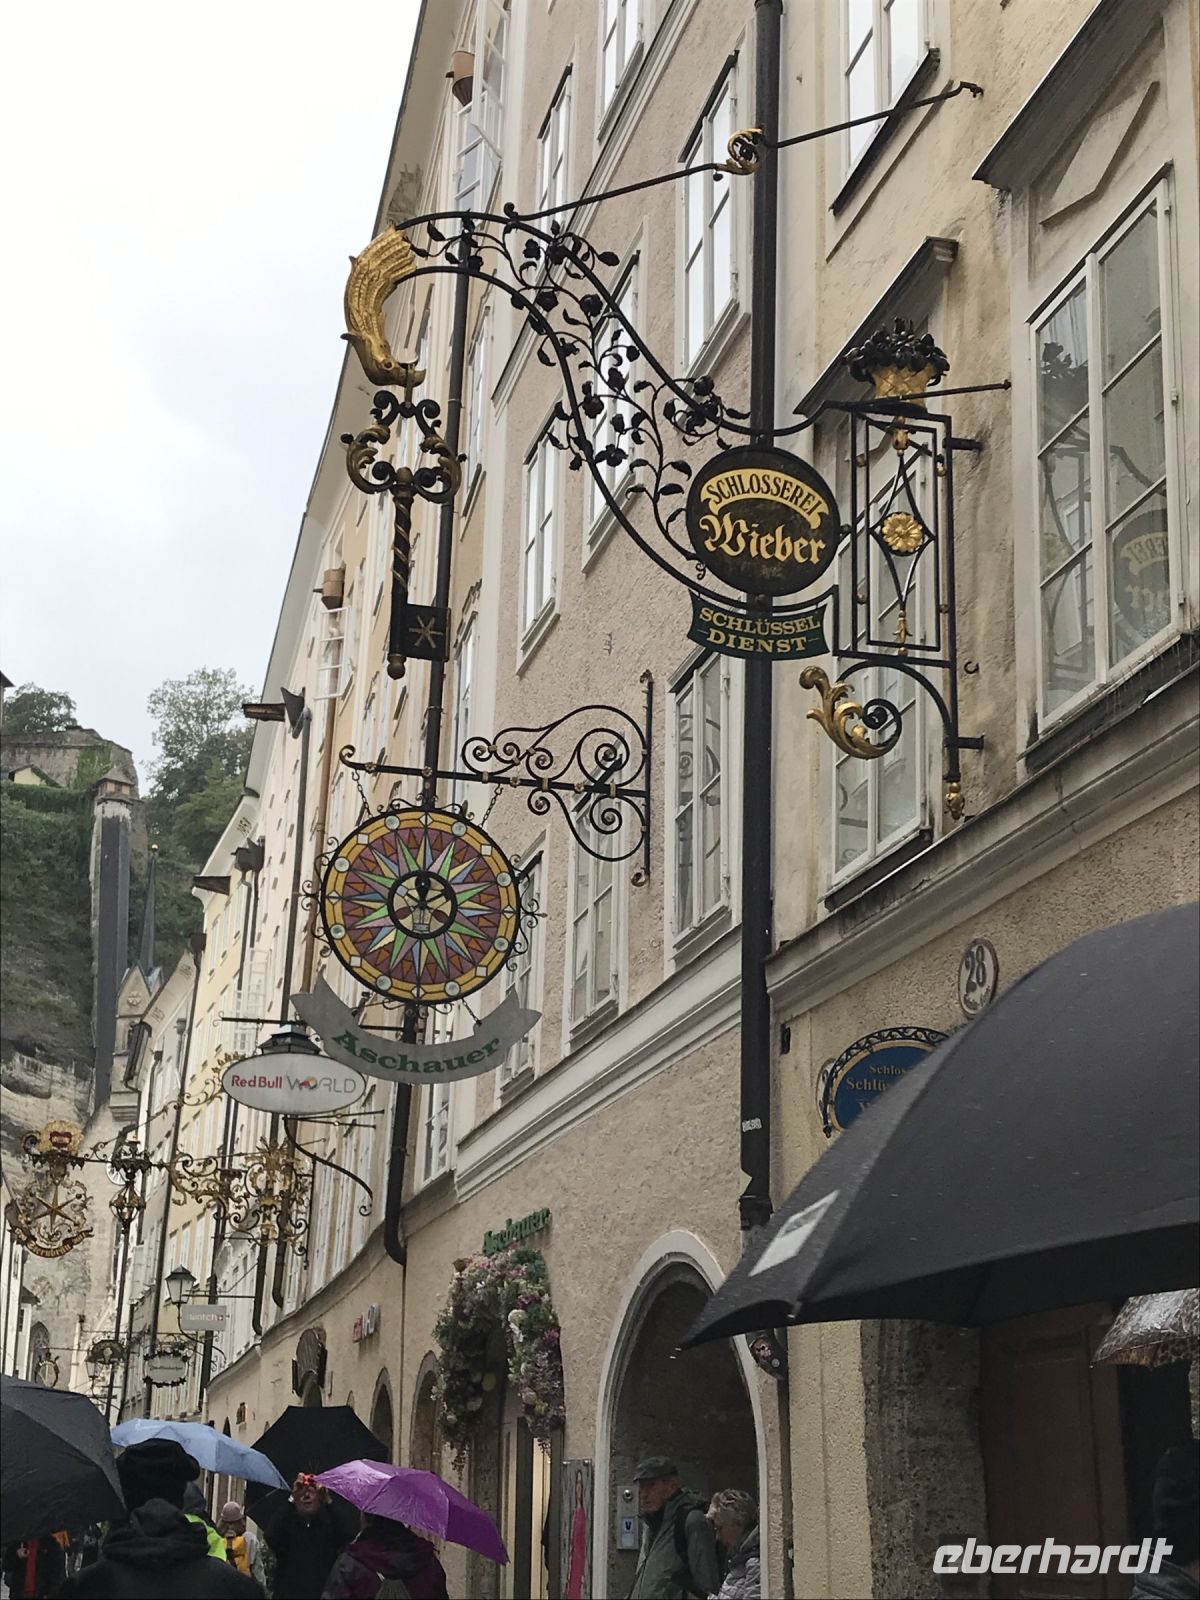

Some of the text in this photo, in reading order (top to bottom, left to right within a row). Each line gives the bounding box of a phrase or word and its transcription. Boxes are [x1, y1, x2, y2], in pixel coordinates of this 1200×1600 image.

[706, 473, 822, 516] SCHLOSSEREI
[699, 512, 826, 564] Wieber
[699, 607, 820, 635] SCHLÜSSEL
[706, 628, 807, 653] DIENST
[964, 945, 987, 993] 28
[331, 1029, 500, 1073] Aschauer
